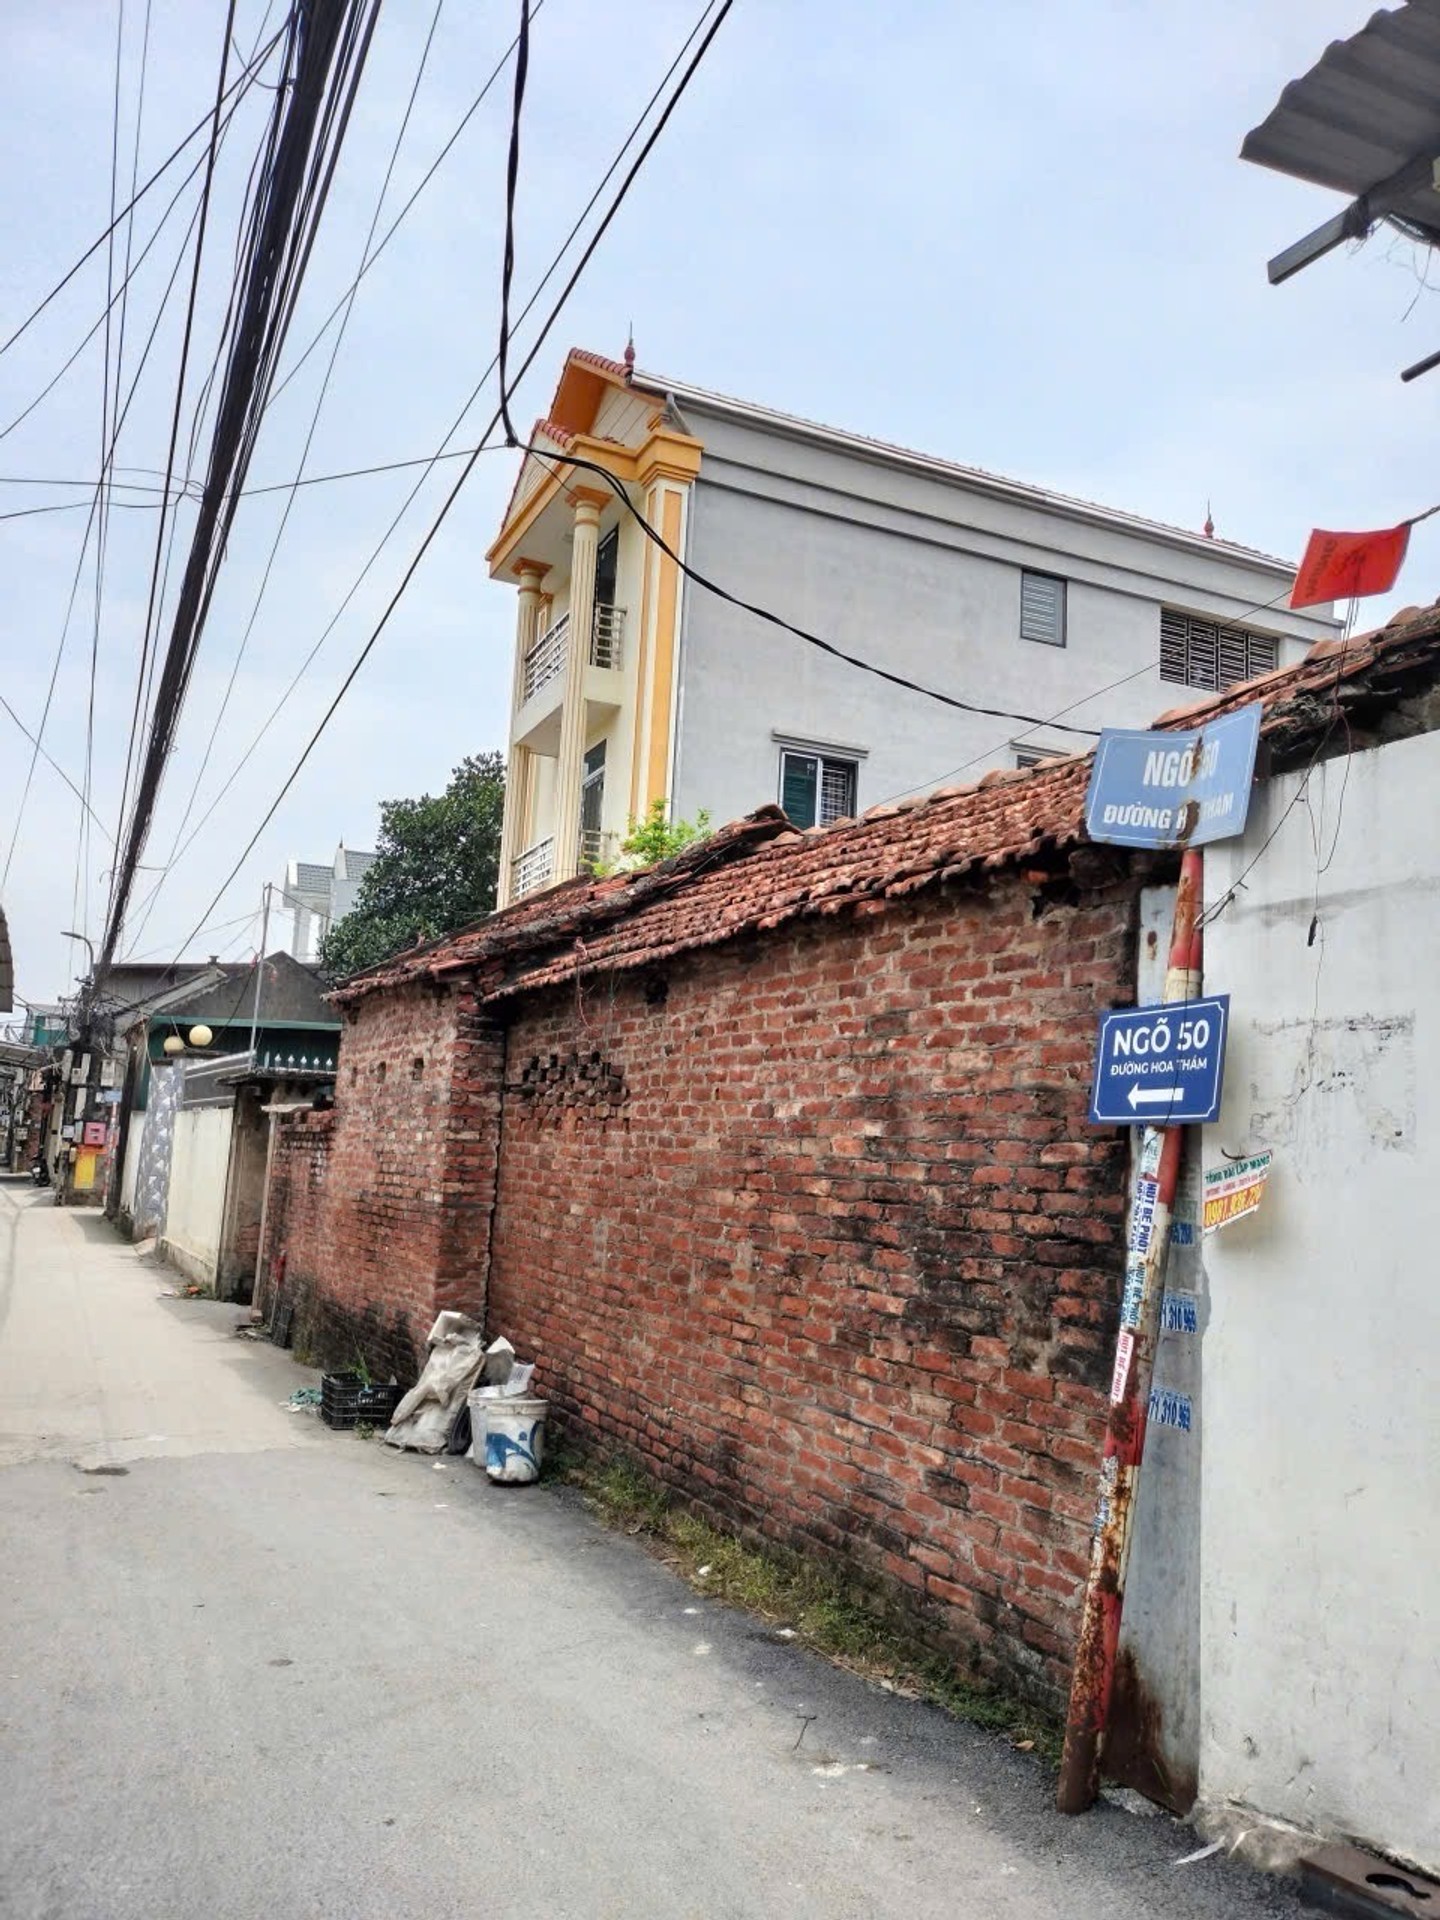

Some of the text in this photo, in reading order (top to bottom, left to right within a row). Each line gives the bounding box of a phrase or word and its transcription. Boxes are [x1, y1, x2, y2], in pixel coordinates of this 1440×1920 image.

[1143, 743, 1194, 788] NGÕ
[1113, 1017, 1211, 1057] NGÕ 50
[1110, 1060, 1149, 1077] ĐƯỜNG
[1150, 1060, 1175, 1075] HOA
